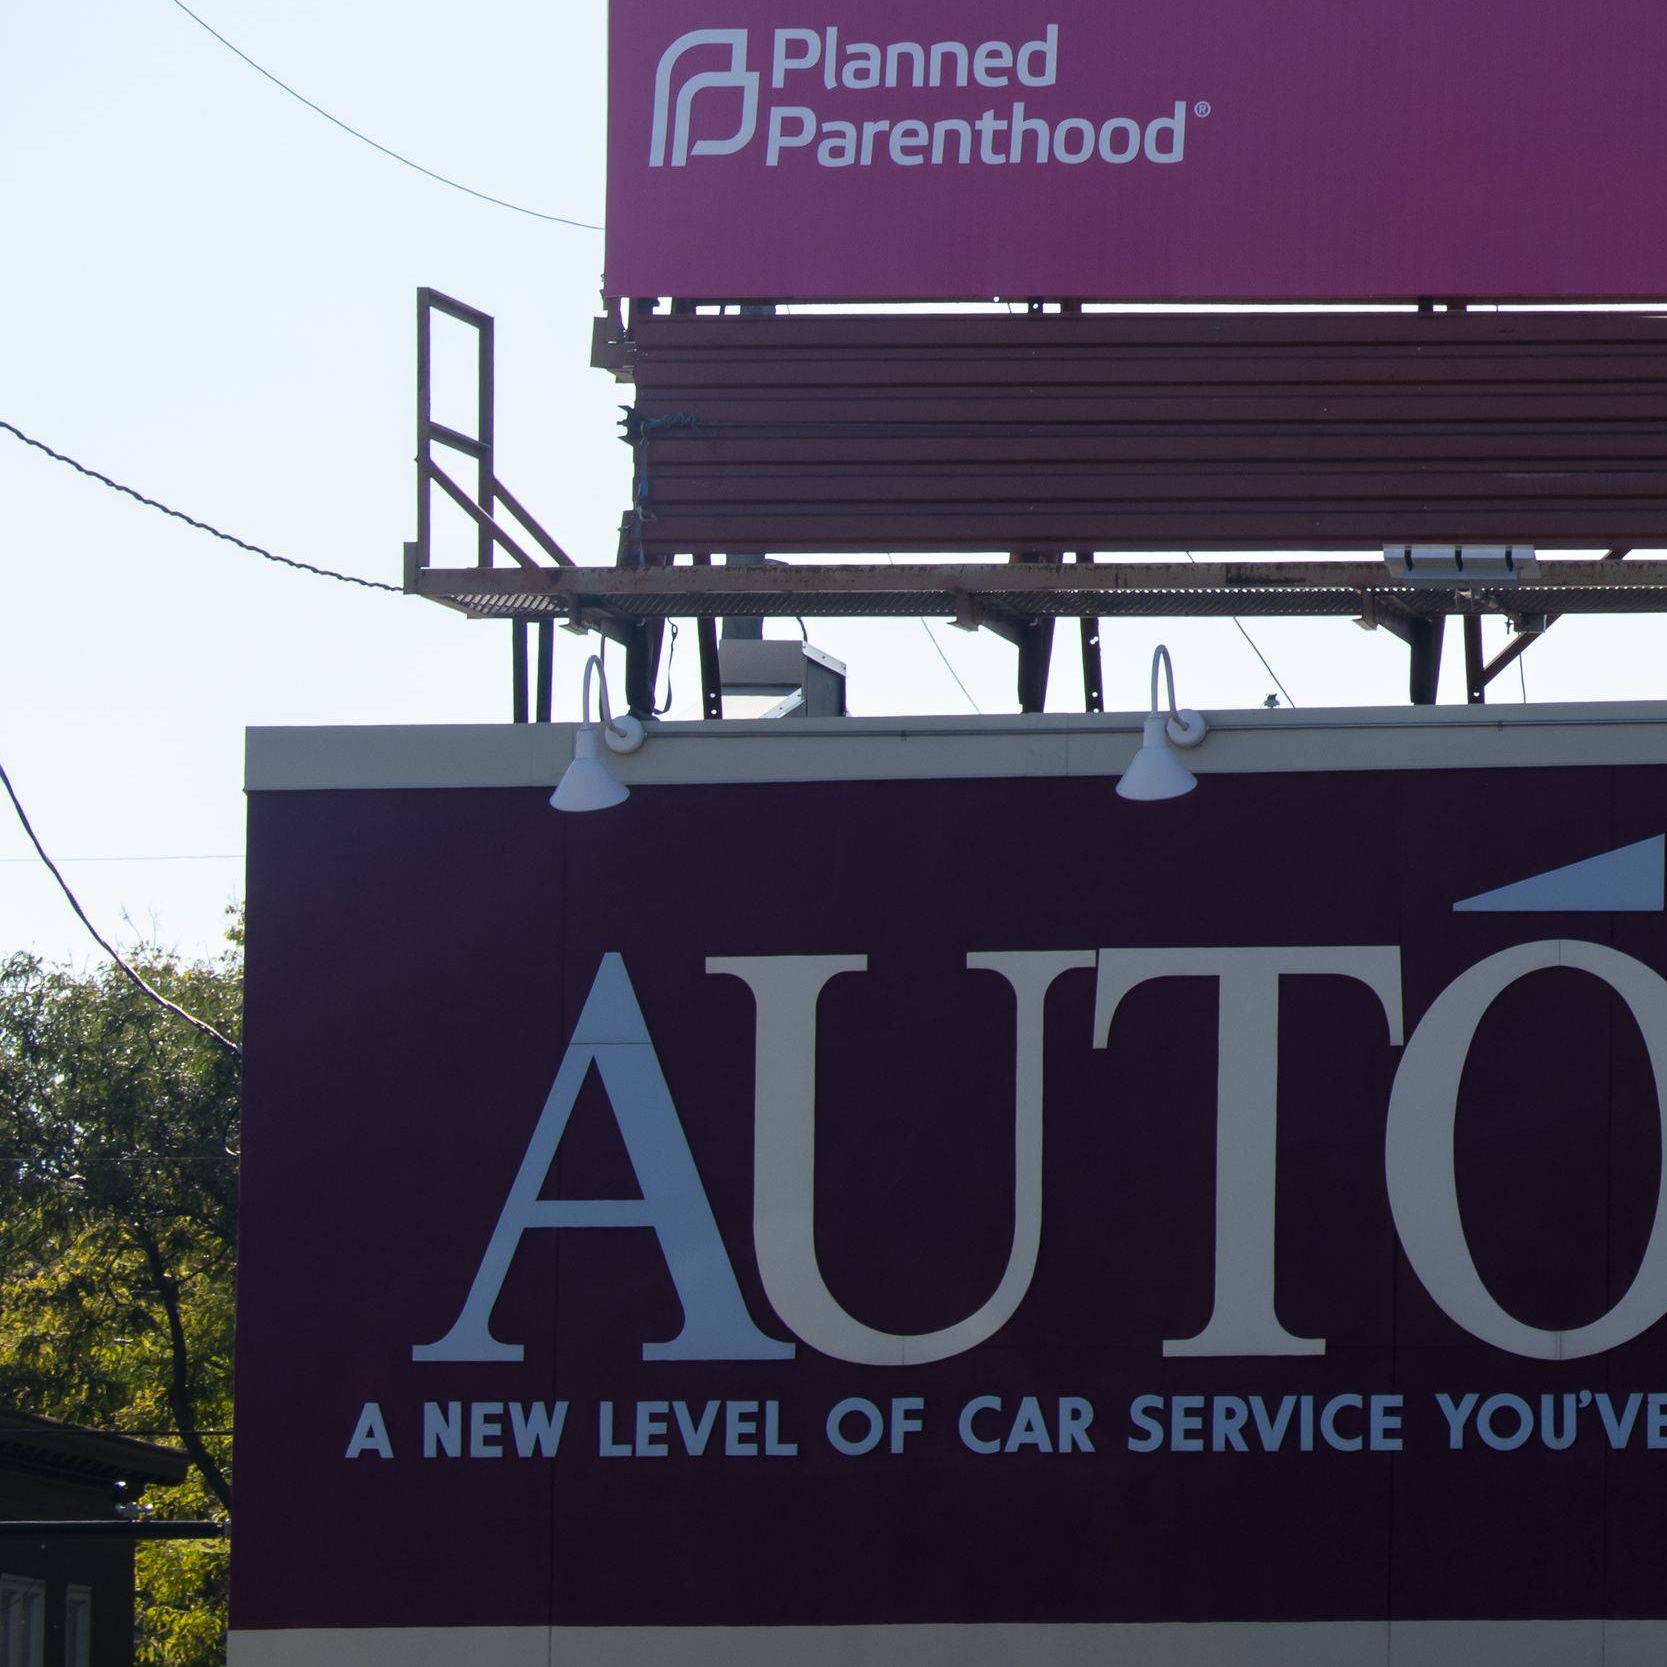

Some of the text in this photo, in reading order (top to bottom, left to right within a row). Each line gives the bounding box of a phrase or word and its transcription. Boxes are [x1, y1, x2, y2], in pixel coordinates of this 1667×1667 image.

[771, 23, 1059, 90] Planned
[344, 1402, 394, 1459] A
[423, 1400, 569, 1458] NEW
[599, 1399, 798, 1457] LEVEL
[826, 1396, 925, 1456] OF
[958, 1395, 1096, 1454] CAR
[1127, 1393, 1404, 1453] SERVICE
